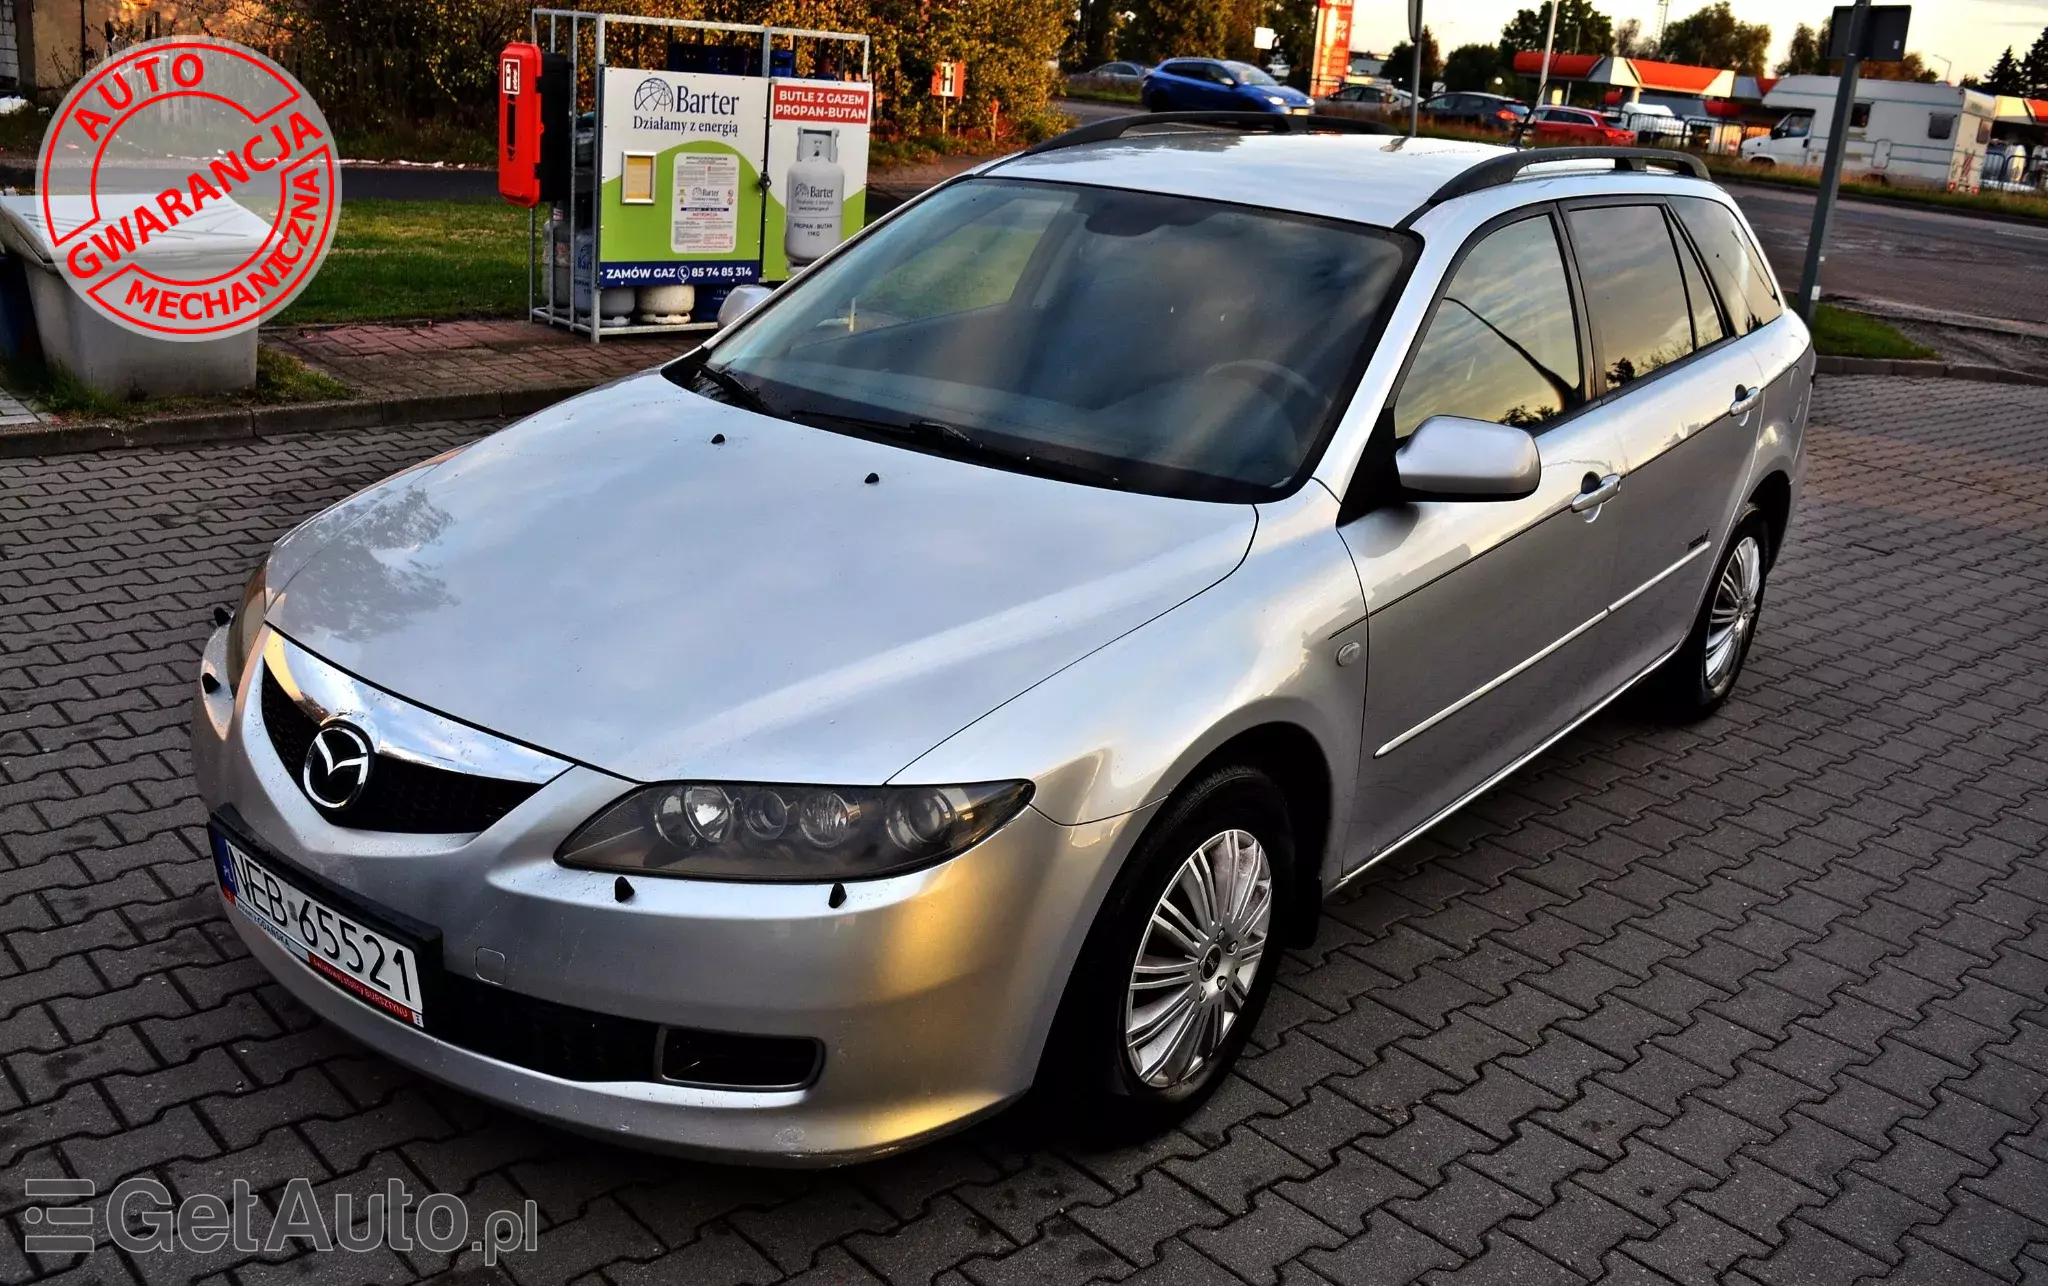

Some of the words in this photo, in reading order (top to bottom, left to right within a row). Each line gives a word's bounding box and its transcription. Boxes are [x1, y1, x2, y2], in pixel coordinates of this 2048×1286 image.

[676, 85, 740, 116] Barter
[780, 90, 815, 102] BUTLE
[817, 92, 824, 103] Z
[826, 93, 865, 106] GAZEM
[775, 104, 867, 119] PROPAN-BUTAN
[633, 115, 687, 136] Działamy
[690, 121, 697, 132] z
[699, 120, 739, 137] energią
[702, 188, 719, 197] Barter
[810, 186, 834, 198] Barter
[606, 266, 651, 280] ZAMÓW
[653, 268, 676, 279] GAZ
[691, 267, 704, 278] 85
[706, 267, 720, 278] 74
[721, 266, 734, 277] 85
[735, 266, 753, 277] 314
[228, 845, 288, 927] NEB
[299, 899, 412, 1002] 65521
